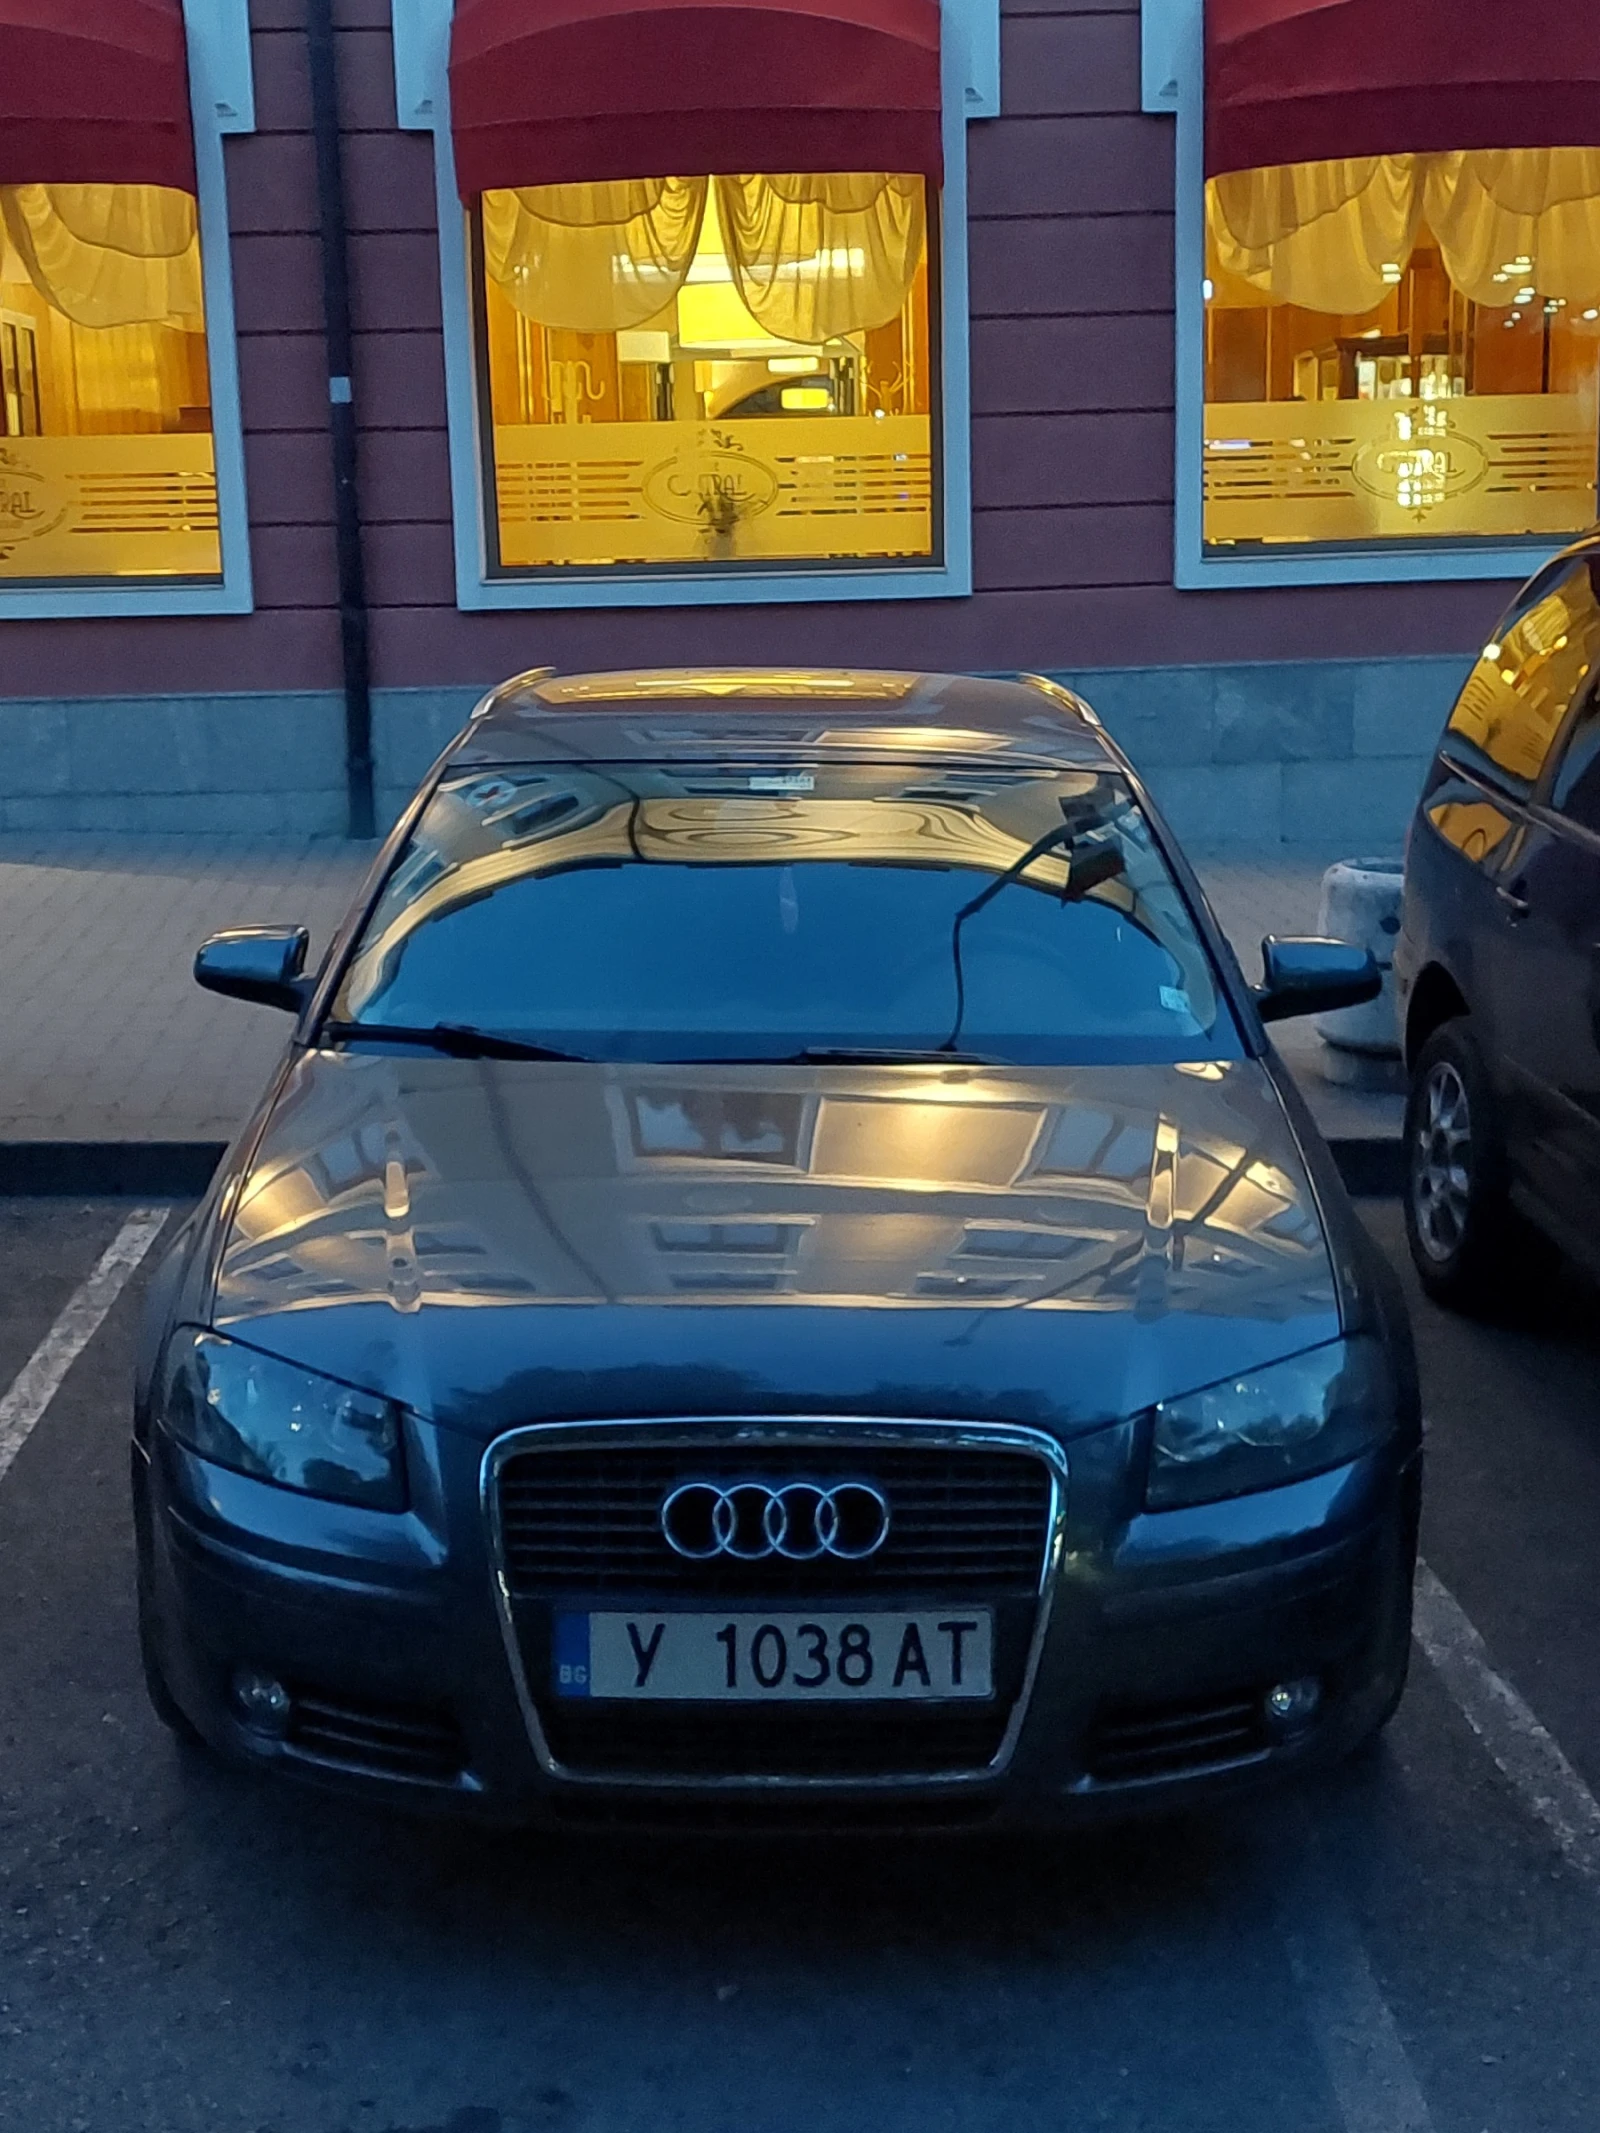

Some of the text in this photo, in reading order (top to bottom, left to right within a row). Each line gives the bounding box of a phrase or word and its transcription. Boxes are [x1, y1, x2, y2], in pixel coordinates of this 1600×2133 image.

[559, 1664, 587, 1684] BG
[716, 1623, 872, 1688] 1038
[892, 1621, 977, 1687] AT
